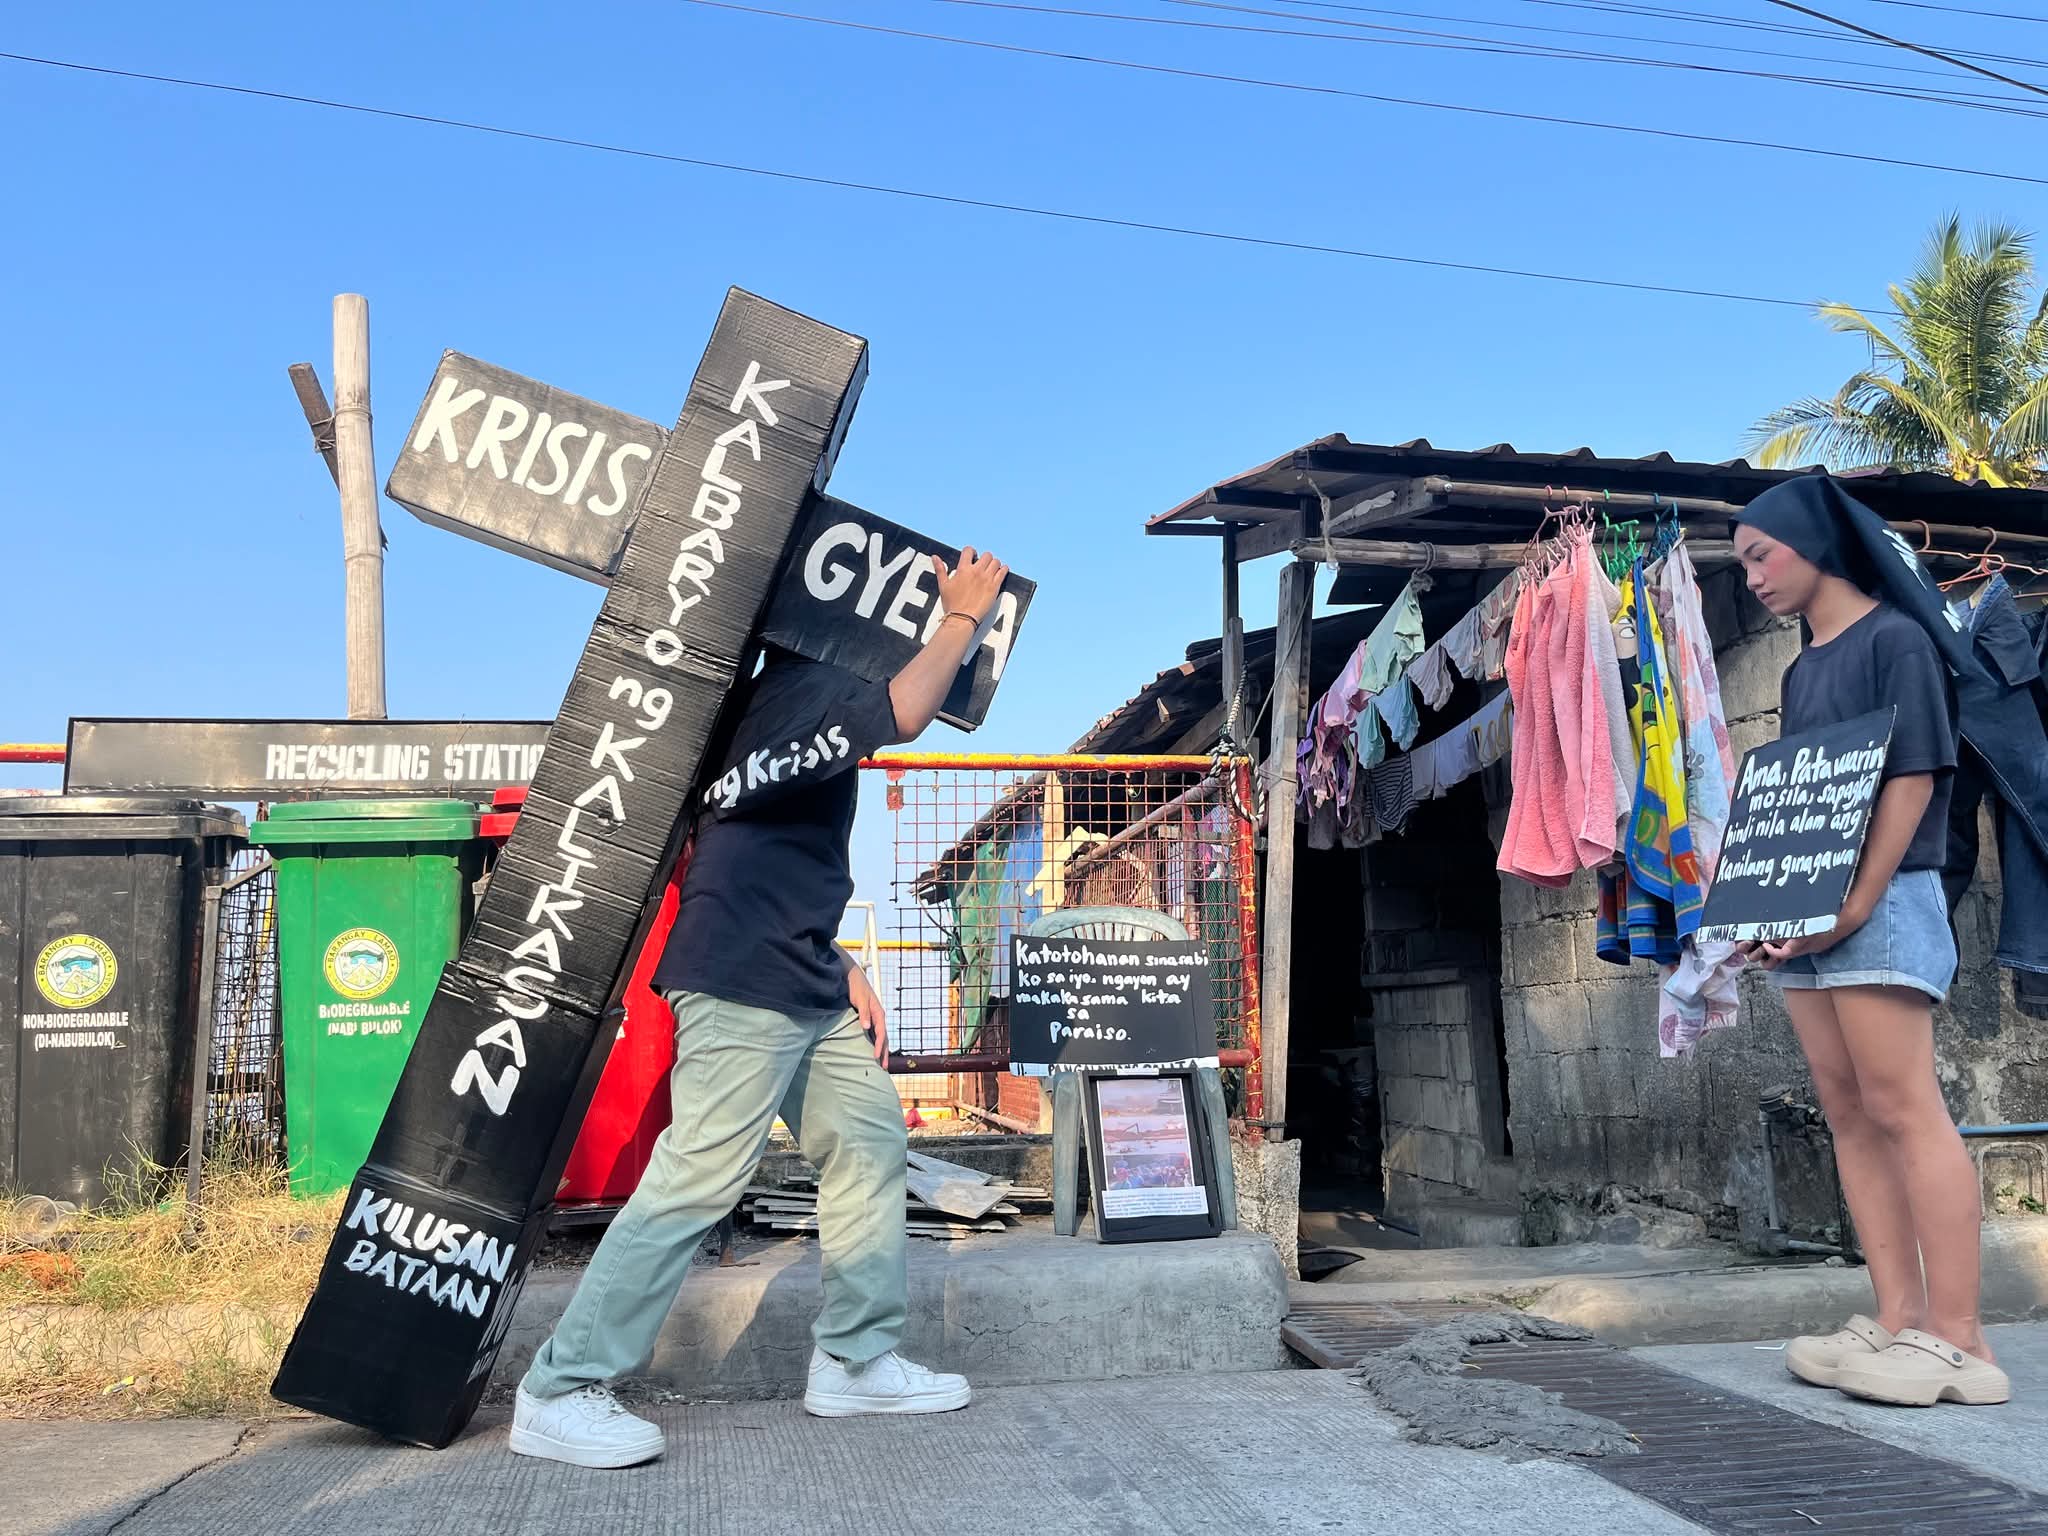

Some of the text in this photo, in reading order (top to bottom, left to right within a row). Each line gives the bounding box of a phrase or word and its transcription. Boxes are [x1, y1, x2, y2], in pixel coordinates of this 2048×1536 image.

[413, 377, 651, 516] KRISIS
[644, 360, 792, 666] KALBARYO
[608, 675, 674, 731] ng
[265, 744, 430, 781] RECYCLING
[1737, 754, 1787, 799] Ama,
[1749, 791, 1775, 813] mo
[1724, 807, 1863, 849] hindi nila alam ang
[450, 722, 648, 1117] KALIKASAN
[1752, 920, 1806, 941] SALITA
[38, 938, 114, 975] BARANGAY LAMAO
[328, 931, 396, 962] BARANGAY LAMAO
[1016, 939, 1209, 967] Katotohanan sinasabi
[1046, 972, 1066, 984] sa
[1102, 974, 1157, 990] ngayon
[1166, 973, 1191, 991] ay
[1141, 989, 1182, 1005] kita
[23, 1012, 129, 1029] NON-BIODEGRADABLE
[1066, 1007, 1090, 1020] sa
[35, 1031, 115, 1052] (DI-NABUBULOK)
[345, 1188, 518, 1282] KILUSAN
[343, 1239, 491, 1319] BATAAN
